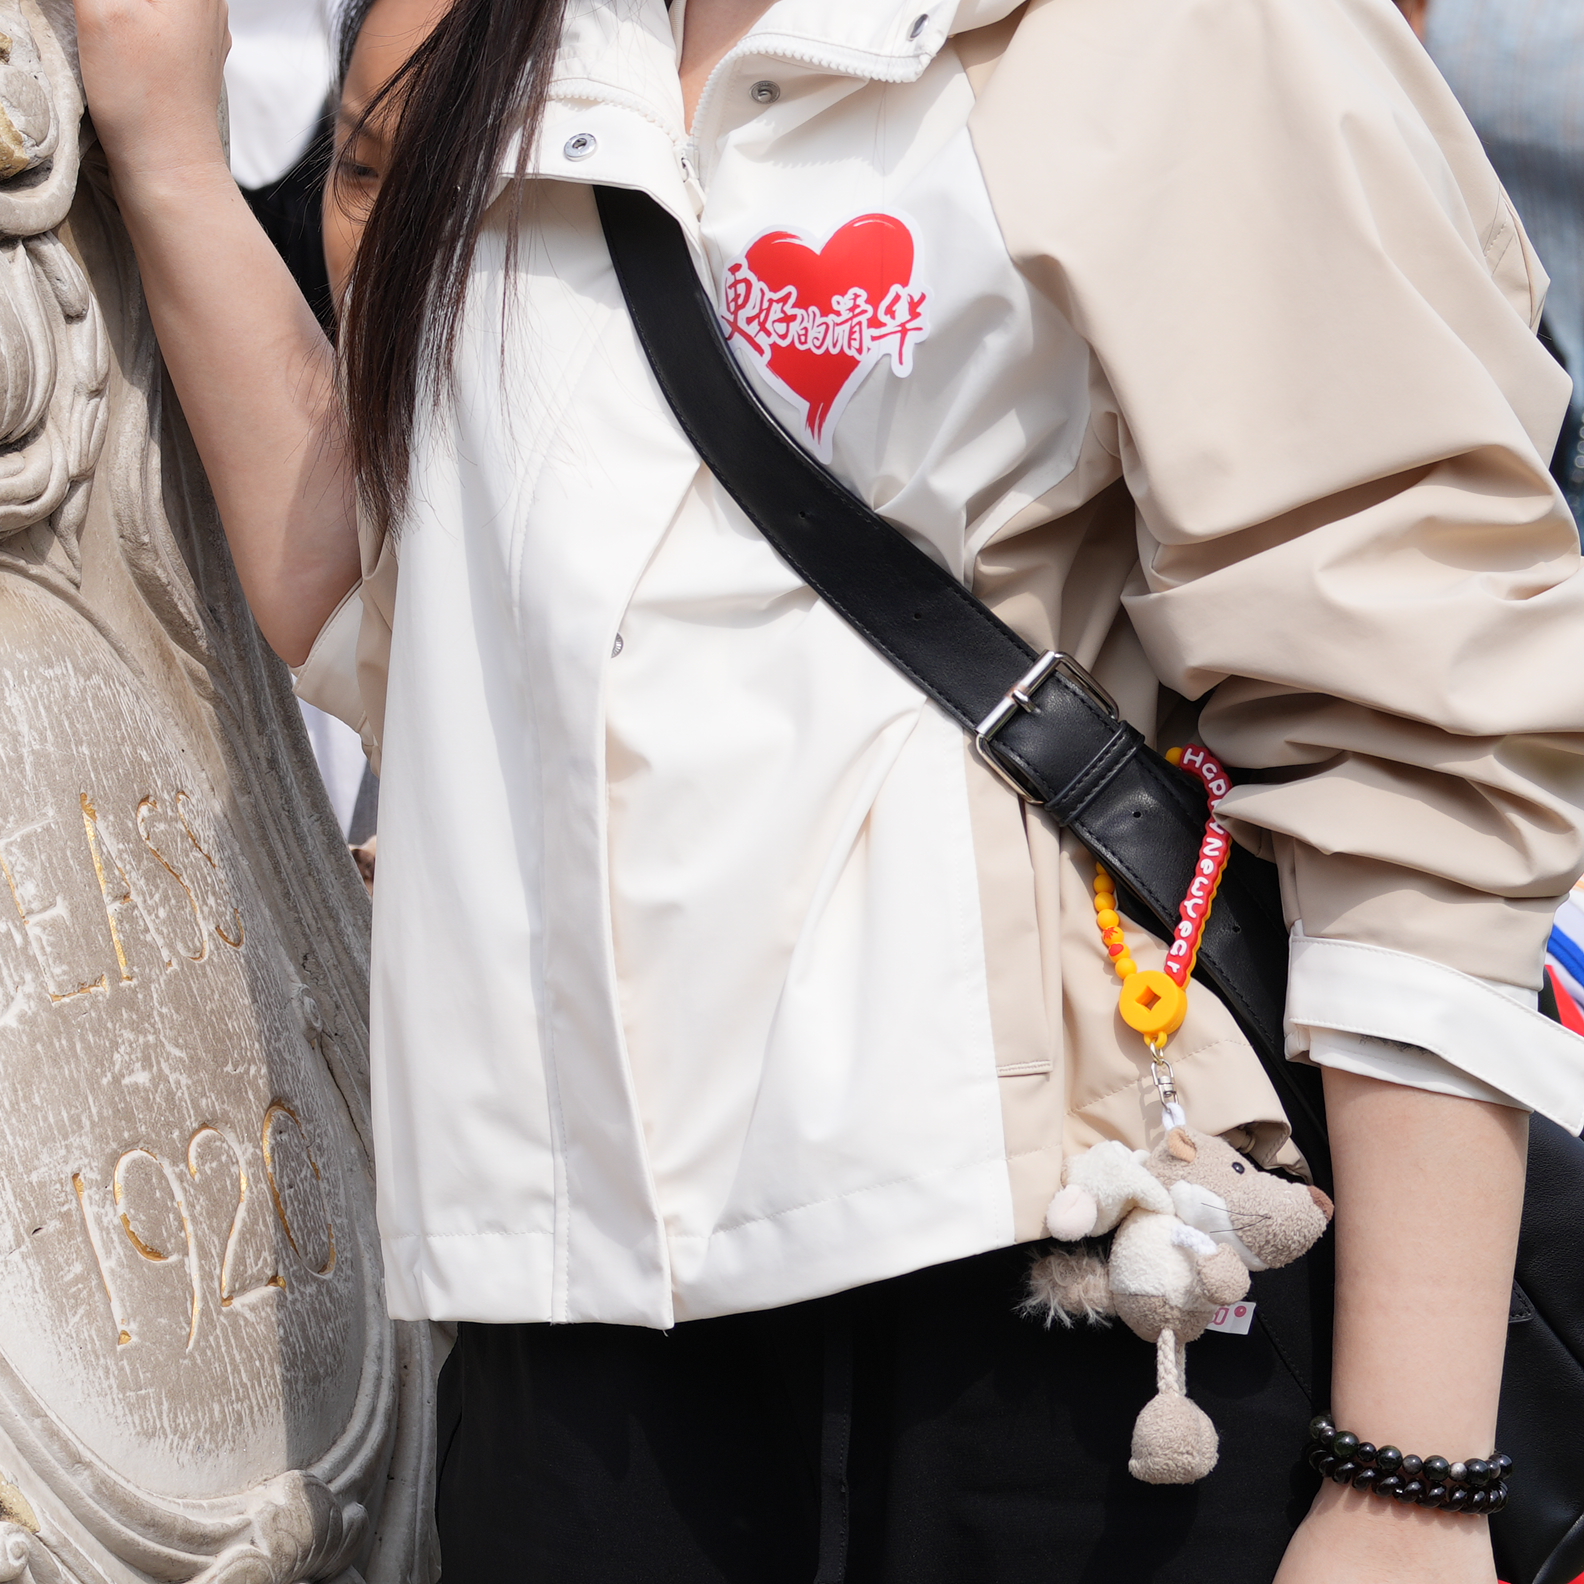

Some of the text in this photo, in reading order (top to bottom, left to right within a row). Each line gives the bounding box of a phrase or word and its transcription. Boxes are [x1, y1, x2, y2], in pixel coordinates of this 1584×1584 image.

[722, 262, 927, 366] 更好的清华
[1183, 748, 1227, 835] Hapy
[71, 1099, 337, 1354] 1920
